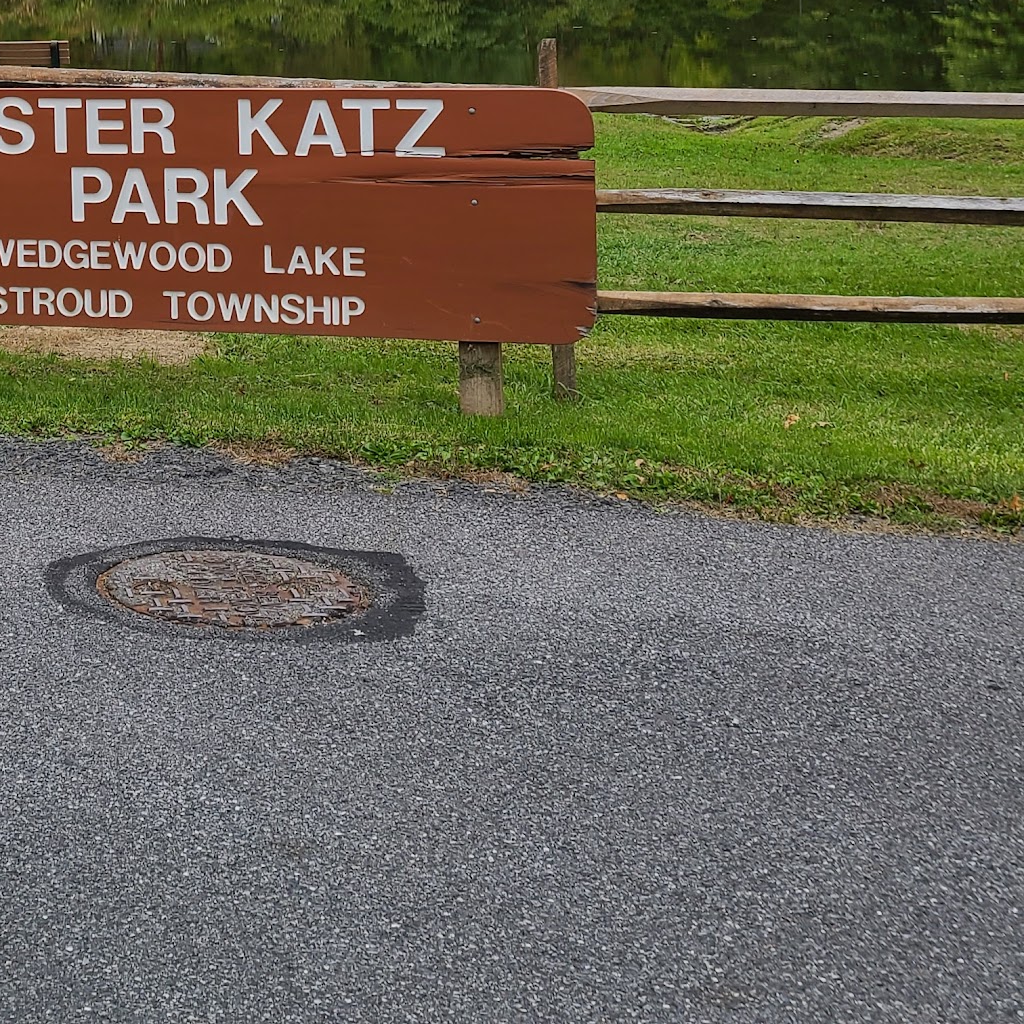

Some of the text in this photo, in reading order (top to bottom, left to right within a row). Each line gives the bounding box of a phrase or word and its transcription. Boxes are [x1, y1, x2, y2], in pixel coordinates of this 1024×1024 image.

[237, 99, 446, 158] KATZ
[71, 167, 263, 226] PARK
[263, 245, 366, 278] LAKE
[162, 291, 365, 326] TOWNSHIP
